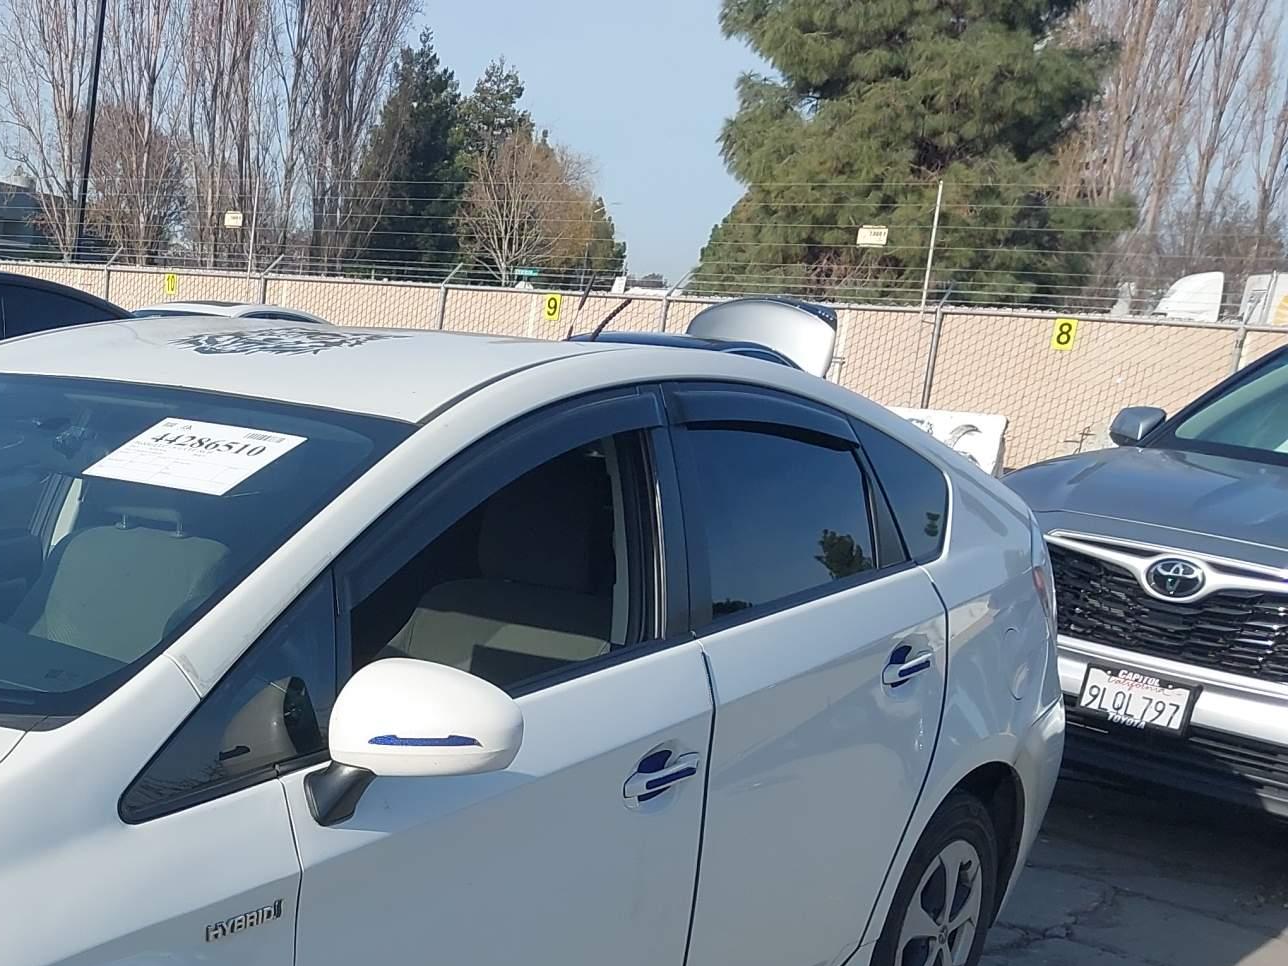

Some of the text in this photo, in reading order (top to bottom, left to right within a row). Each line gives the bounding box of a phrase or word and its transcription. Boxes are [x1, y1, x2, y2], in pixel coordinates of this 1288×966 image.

[167, 275, 175, 291] 10
[547, 297, 558, 316] 9
[1056, 322, 1072, 345] 8
[150, 432, 267, 457] 44286510
[1118, 669, 1161, 687] CAPITOL
[1084, 684, 1181, 728] 9LQL797
[1107, 712, 1147, 729] TOYOTA
[205, 904, 274, 942] HYBRID
